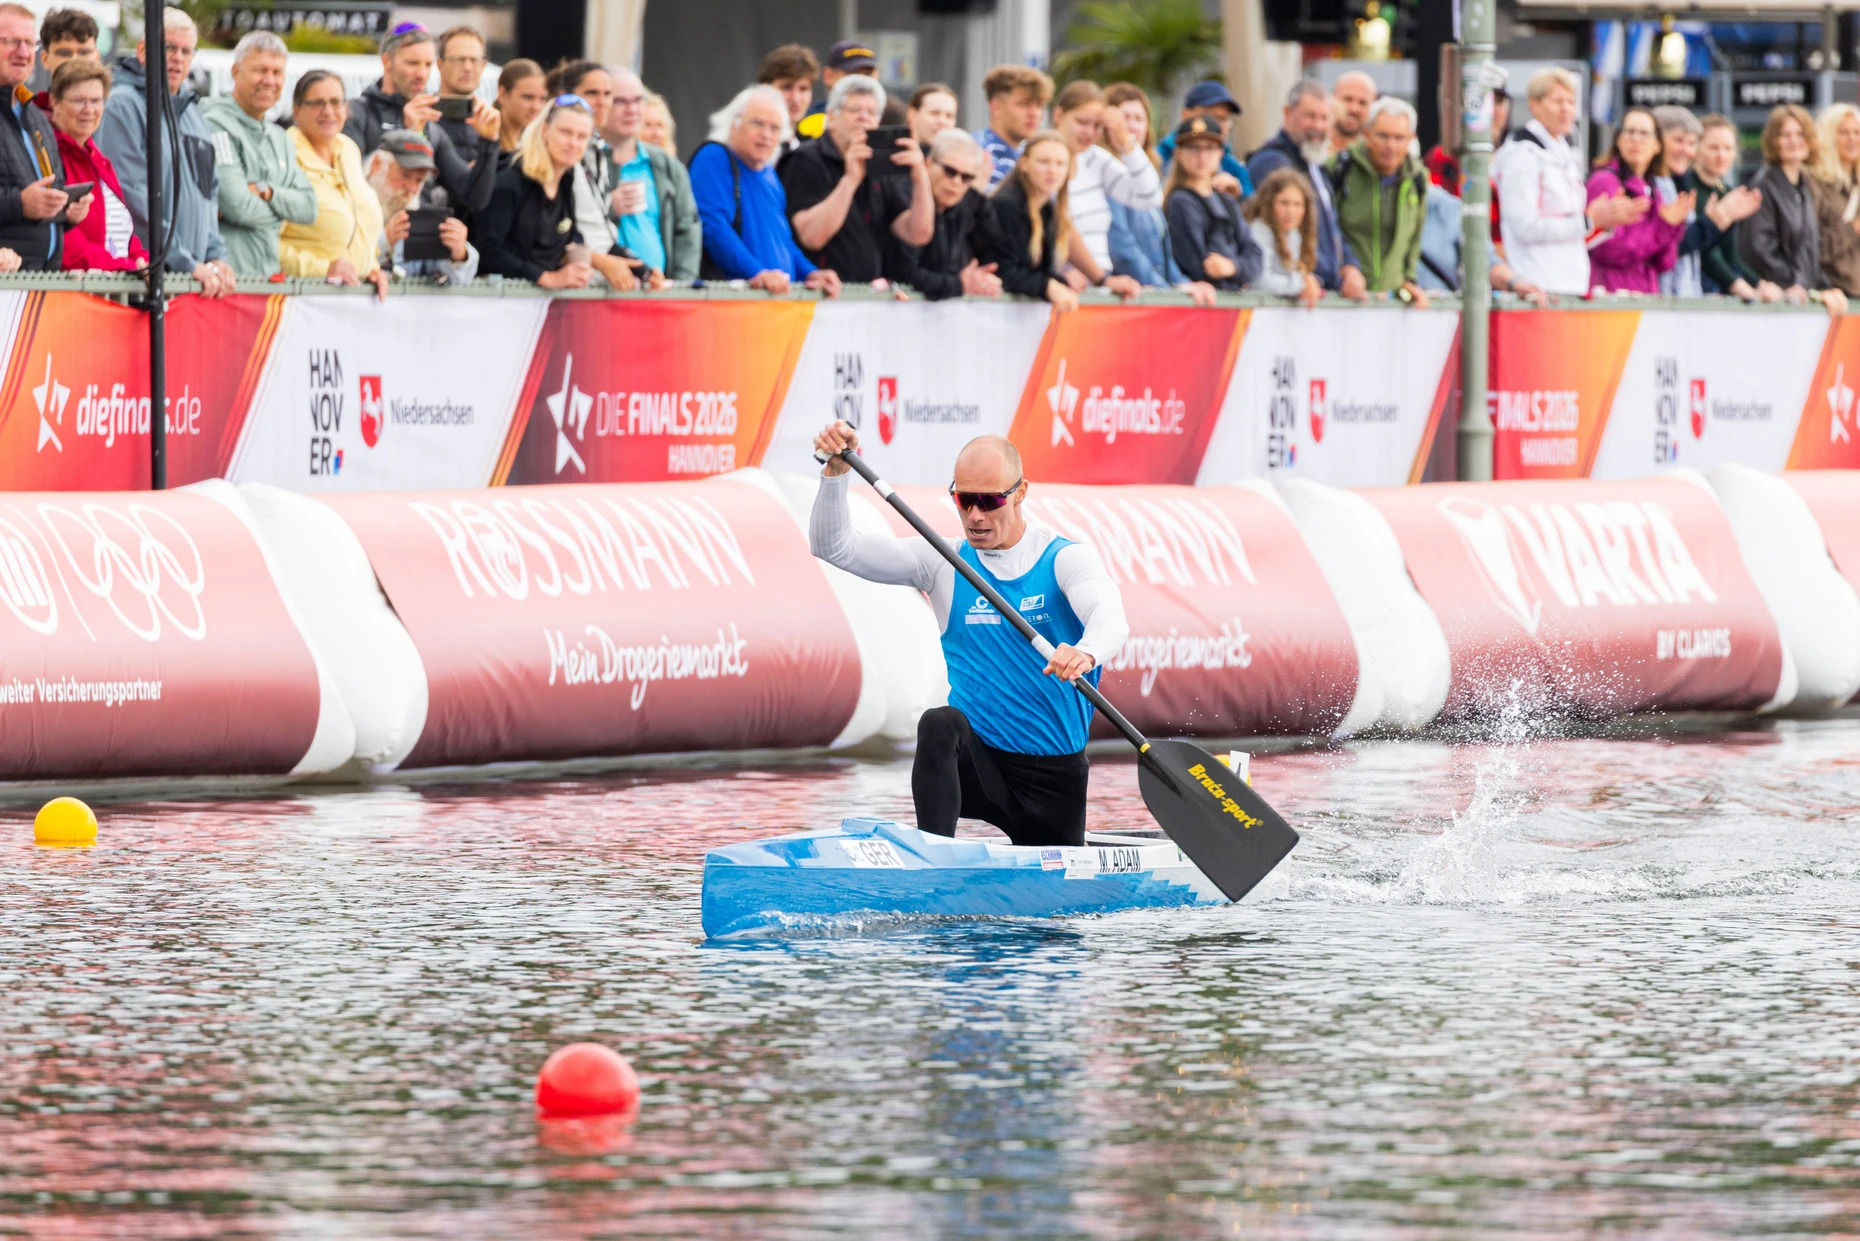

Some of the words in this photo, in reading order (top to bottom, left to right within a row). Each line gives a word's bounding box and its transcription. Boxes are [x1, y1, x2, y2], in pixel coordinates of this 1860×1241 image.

[1631, 83, 1696, 102] PEPSI
[1740, 82, 1805, 102] PEPSI
[309, 349, 344, 388] HAN
[77, 383, 201, 448] diefina.de
[310, 393, 343, 432] NOV
[390, 398, 473, 425] Niedersachsen
[904, 398, 980, 423] Niedersachsen
[1082, 384, 1185, 444] diefinals.de
[1331, 400, 1400, 423] Niedersachsen
[310, 437, 332, 475] ER
[668, 444, 736, 473] HANNOVER
[1520, 437, 1579, 466] HANNOVER
[408, 496, 755, 601] ROSSMANN
[1501, 501, 1719, 607] VARTA
[1656, 629, 1675, 660] BY
[1676, 628, 1731, 659] CLARIOS
[545, 628, 602, 686] Mein
[585, 622, 749, 711] Drogeriemarkt
[36, 675, 162, 707] Versicherungspartner
[859, 841, 901, 866] GER
[1112, 848, 1141, 873] ADAM
